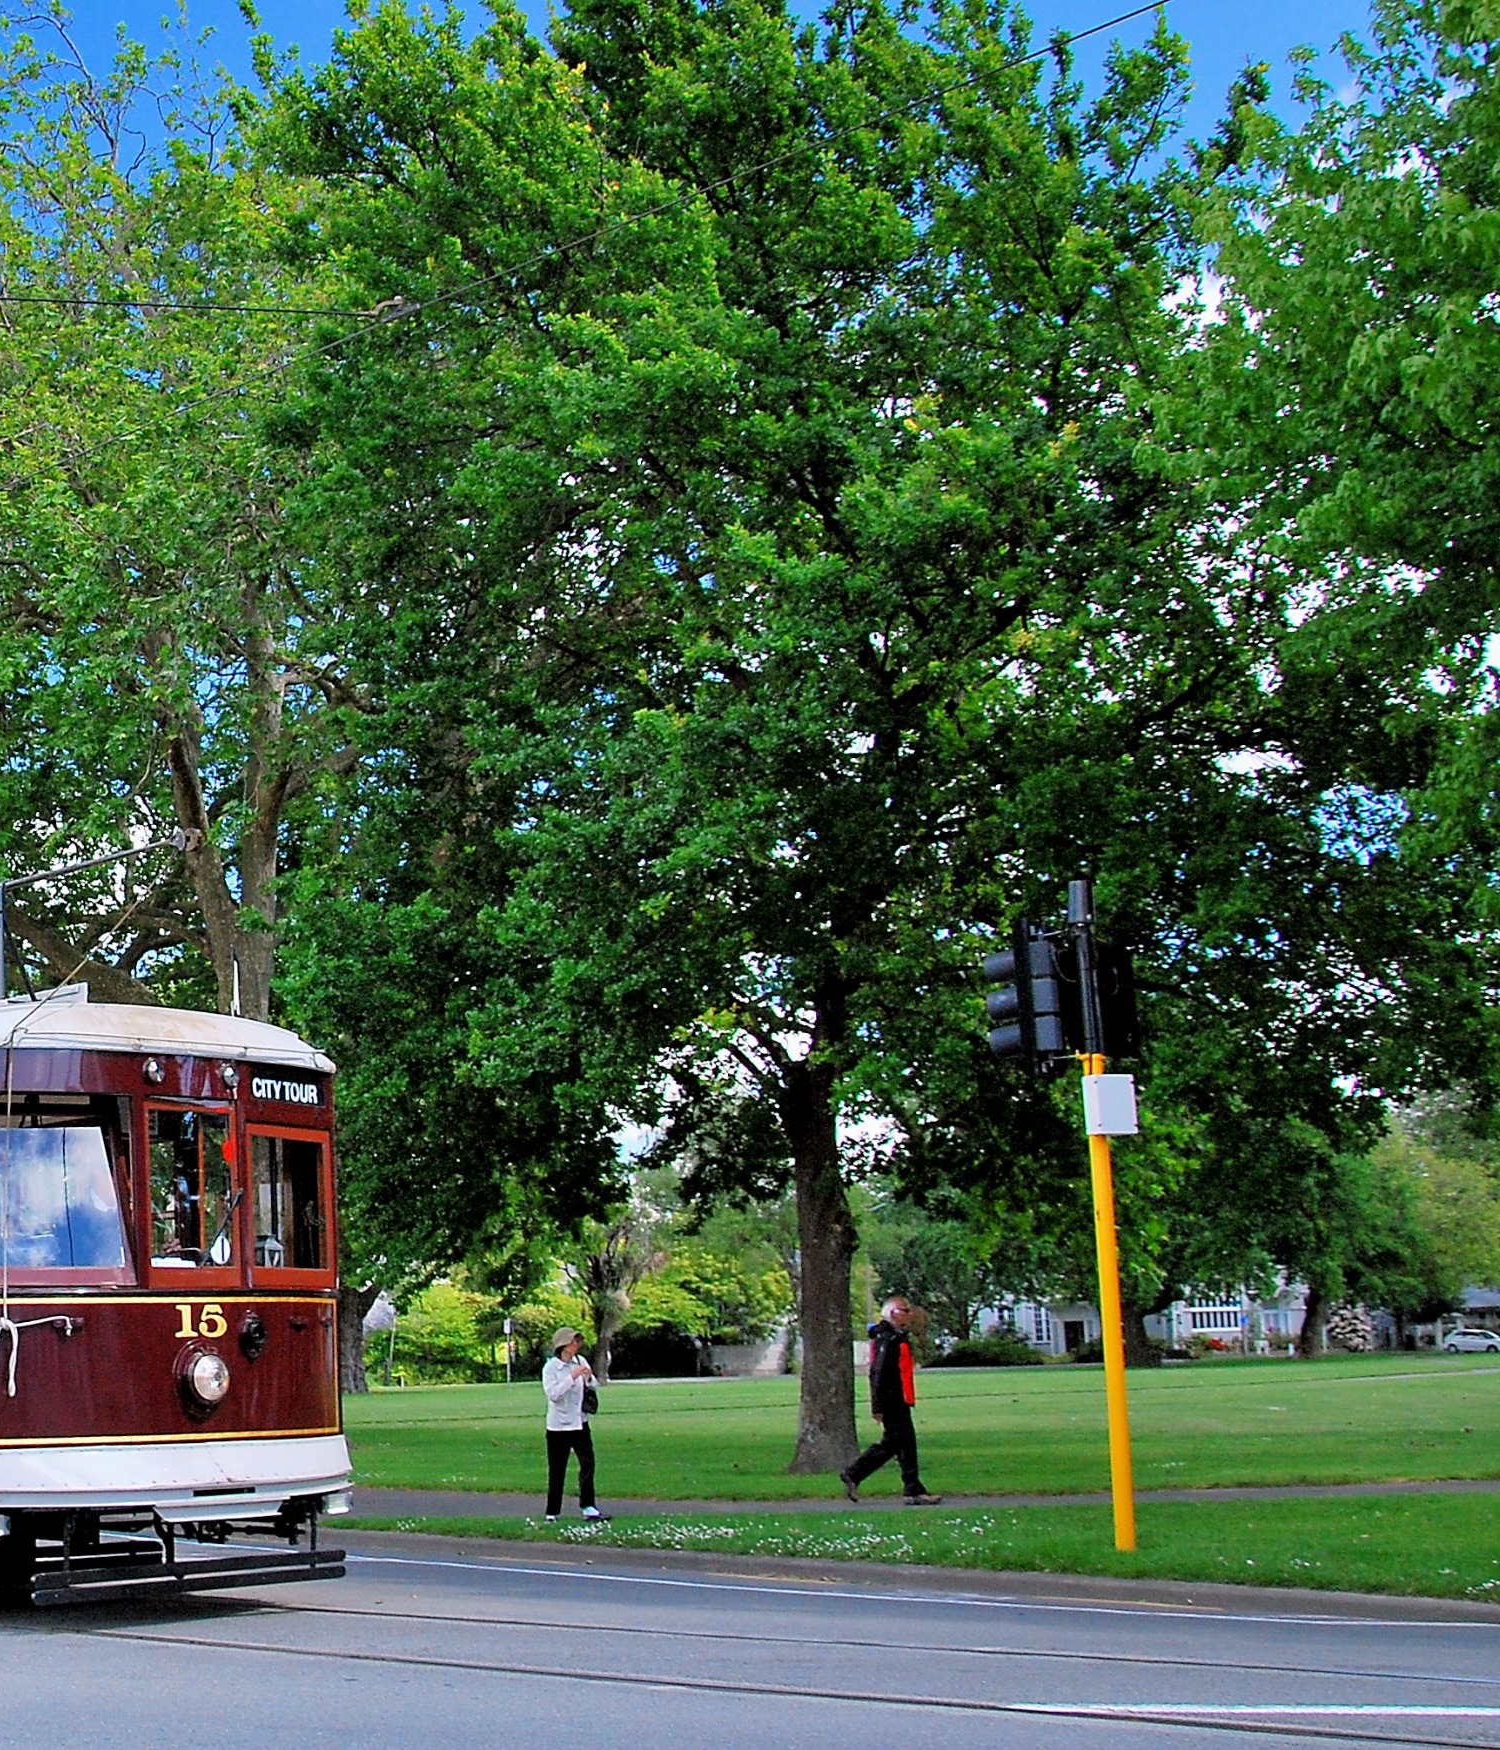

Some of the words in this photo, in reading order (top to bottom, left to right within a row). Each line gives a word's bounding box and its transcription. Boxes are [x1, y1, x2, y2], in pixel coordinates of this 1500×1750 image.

[252, 1077, 281, 1100] CITY
[282, 1081, 319, 1104] TOUR
[175, 1304, 228, 1338] 15
